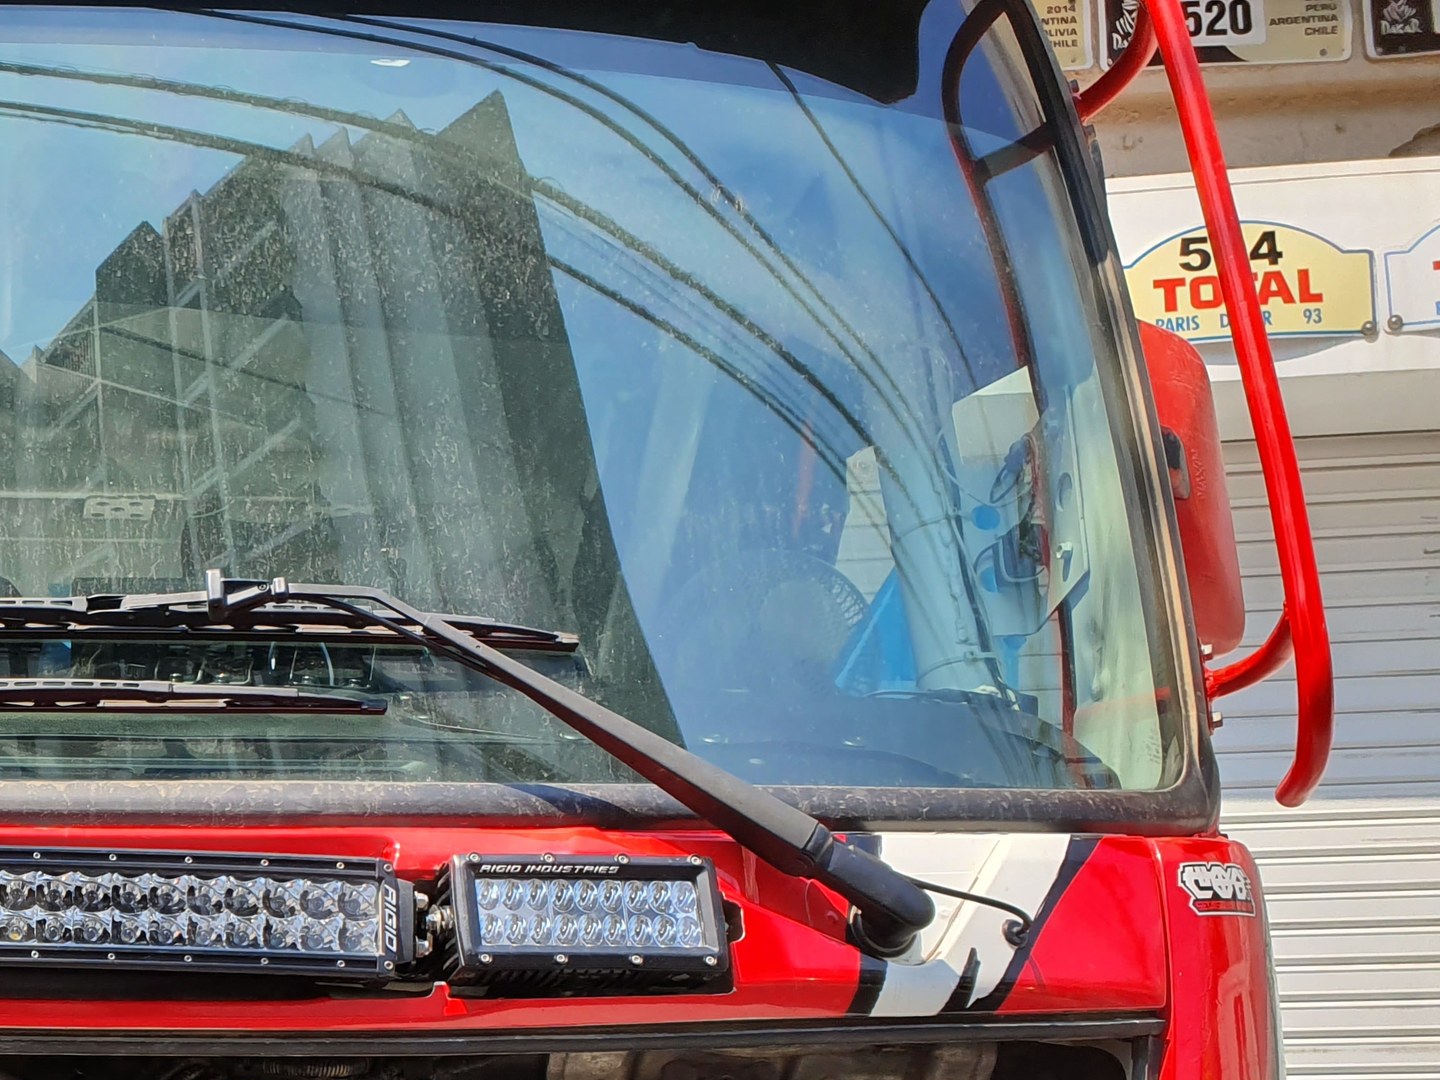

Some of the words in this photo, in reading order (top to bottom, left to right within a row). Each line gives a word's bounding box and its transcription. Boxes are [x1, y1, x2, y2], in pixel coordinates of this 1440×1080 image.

[1046, 4, 1076, 14] 2014
[1269, 14, 1338, 26] ARGENTINA
[1380, 19, 1421, 35] DAKAR
[1304, 26, 1338, 36] CHILE
[1049, 39, 1078, 48] HILE
[1179, 231, 1283, 271] 54
[1153, 269, 1323, 313] TOAL
[1303, 308, 1322, 324] 93
[479, 864, 521, 873] RIGID
[524, 864, 620, 874] INDUSTRIES
[384, 883, 397, 953] RIGID
